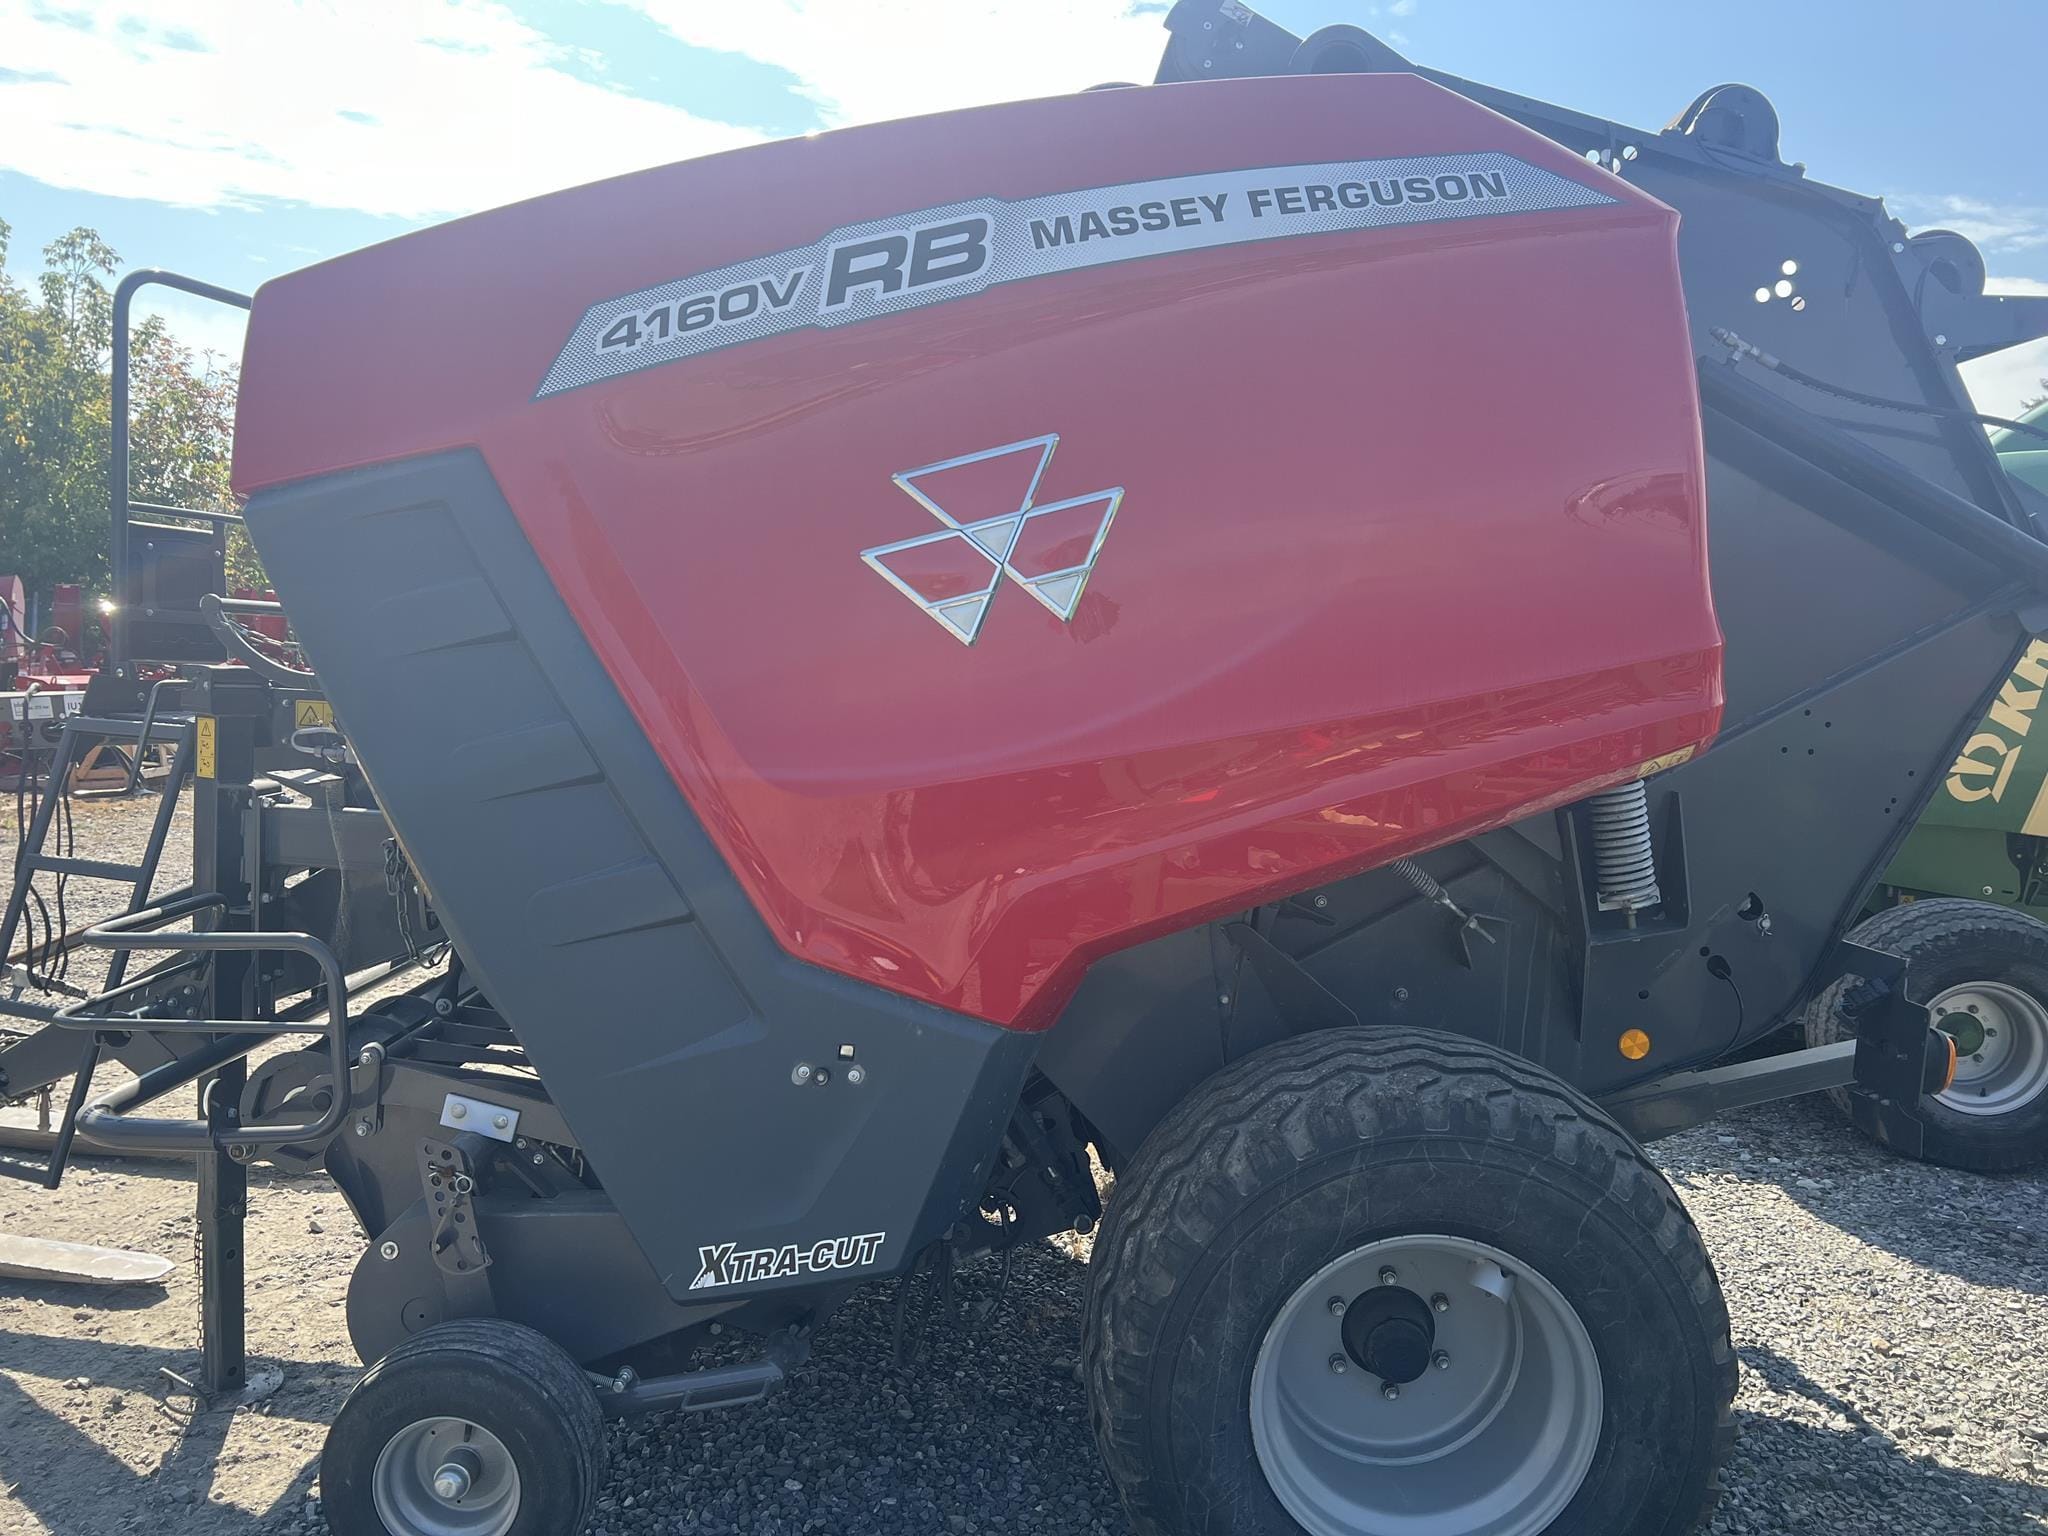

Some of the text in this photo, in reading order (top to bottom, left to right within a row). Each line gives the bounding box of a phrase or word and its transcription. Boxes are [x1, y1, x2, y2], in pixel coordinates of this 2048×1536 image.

[601, 171, 1508, 349] 4160V RB MASSEY FERGUSON
[689, 1232, 886, 1290] XTRA-CUT
